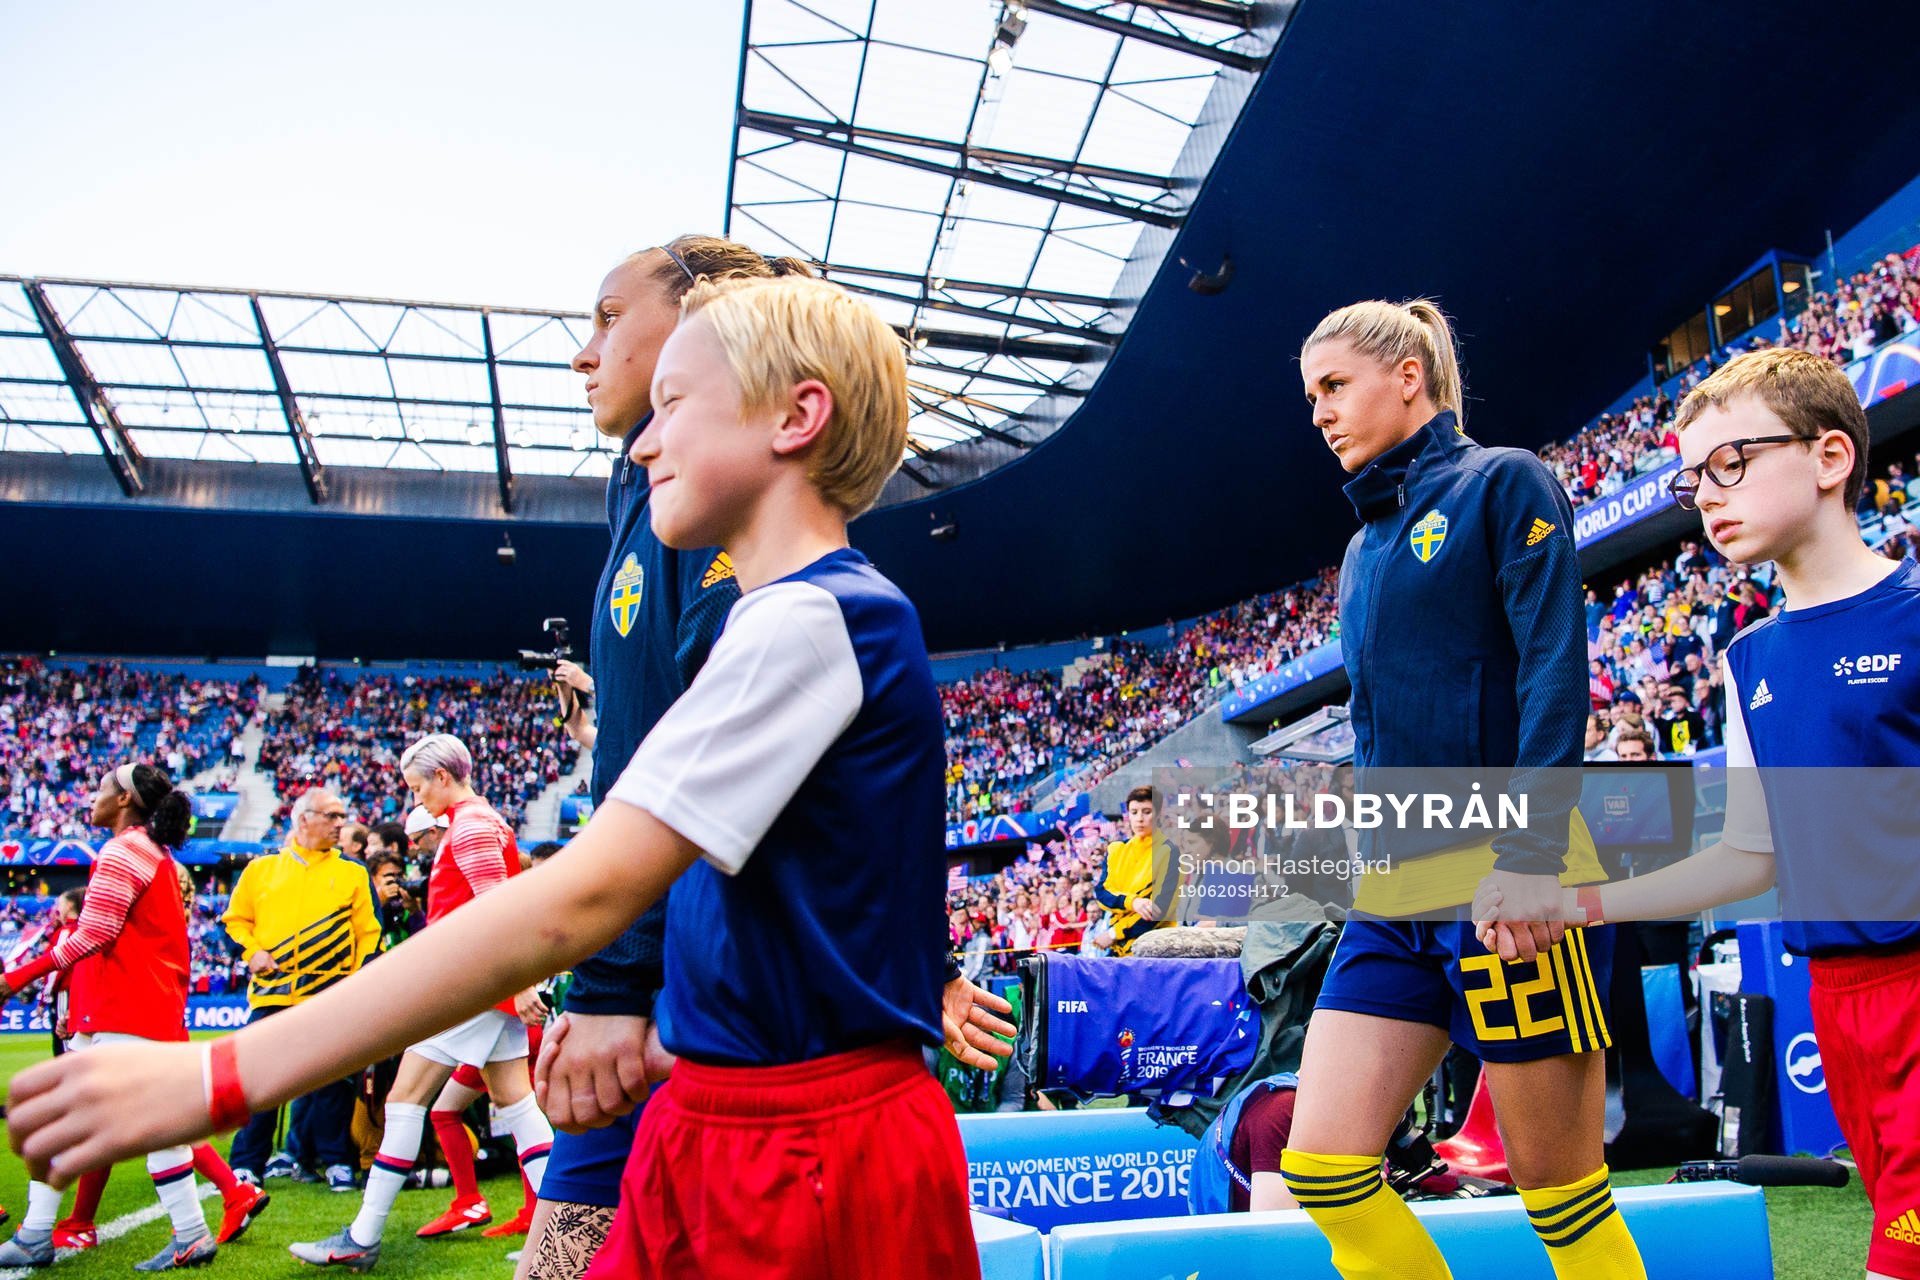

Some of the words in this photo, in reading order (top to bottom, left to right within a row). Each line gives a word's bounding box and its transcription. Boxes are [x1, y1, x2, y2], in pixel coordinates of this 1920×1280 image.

[1623, 482, 1656, 516] CUP
[1526, 524, 1556, 546] adidas
[1607, 801, 1626, 810] VAR
[1459, 952, 1565, 1041] 22
[1058, 1001, 1088, 1013] FIFA
[1137, 1051, 1197, 1066] FRANCE
[1137, 1065, 1168, 1079] 2019
[968, 1161, 1003, 1177] FIFA
[1006, 1156, 1091, 1175] WOMEN'S
[1095, 1151, 1159, 1169] WORLD
[1162, 1148, 1197, 1164] CUP
[1224, 1159, 1234, 1174] FIFA
[968, 1170, 1115, 1208] FRANCE
[1121, 1165, 1192, 1200] 2019
